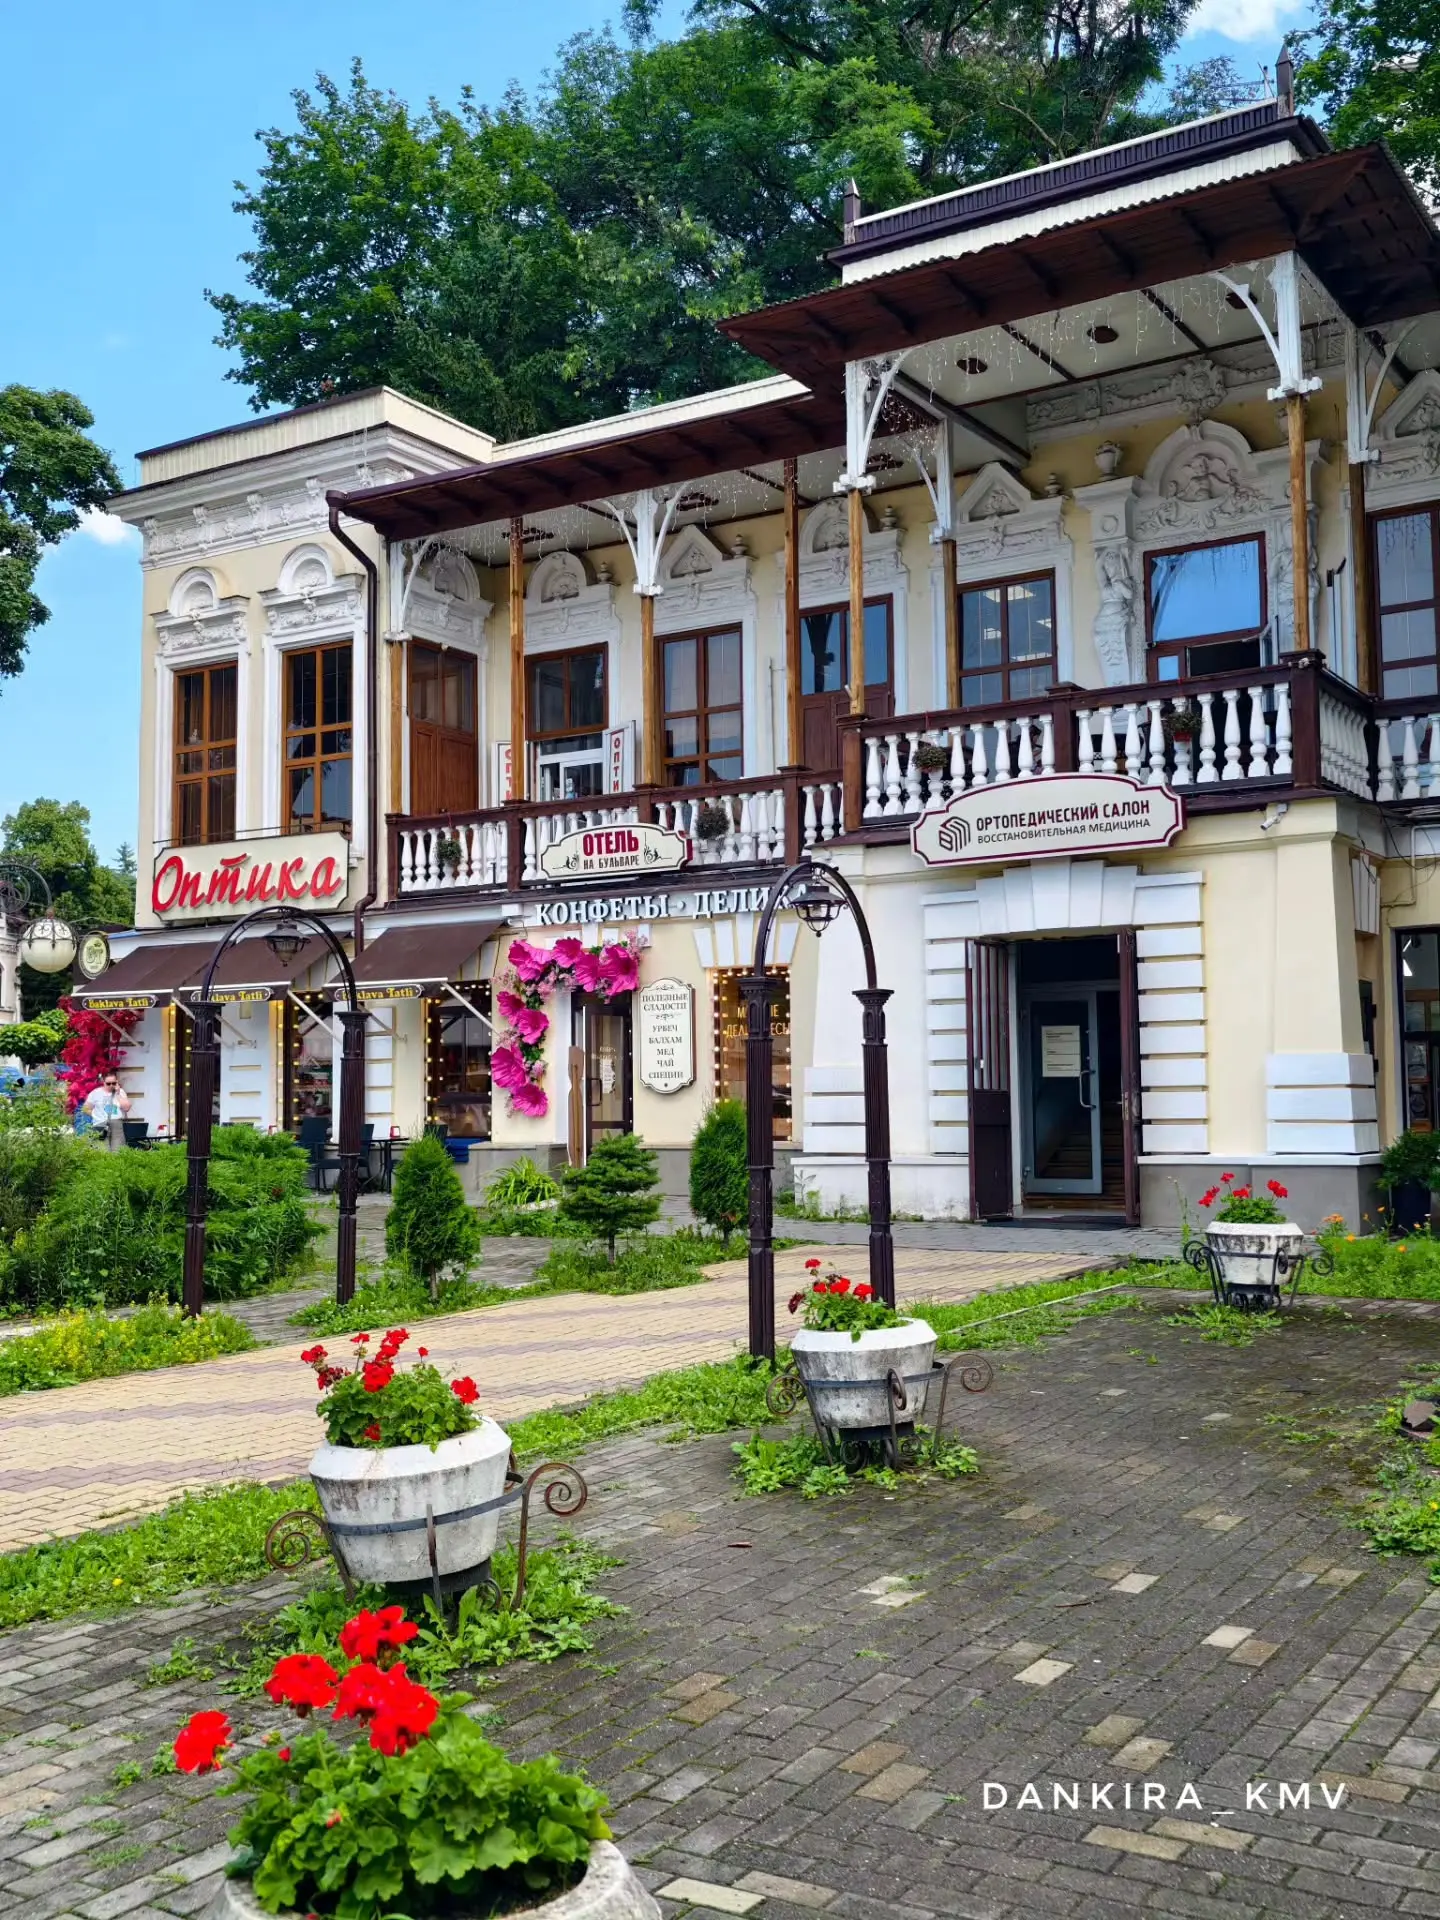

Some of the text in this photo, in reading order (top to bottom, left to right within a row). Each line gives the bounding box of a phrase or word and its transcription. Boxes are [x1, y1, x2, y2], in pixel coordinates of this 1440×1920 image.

[976, 800, 1150, 831] ОРТОПЕДИЧЕСКИЙ САЛОН
[977, 818, 1151, 844] ВОССТАНОВИТЕЛЬНАЯ МЕДИЦИНА
[583, 830, 639, 857] ОТЕЛЬ
[583, 855, 640, 870] НА БУЛЬВАРЕ
[152, 853, 344, 913] Оптика
[535, 895, 668, 925] КОНФЕТЫ
[642, 993, 688, 1003] ПОЛЕЗНЫЕ
[643, 1002, 687, 1012] СЛАДОСТИ
[652, 1024, 678, 1033] УРБЕЧ
[656, 1048, 675, 1056] МЕД
[656, 1059, 674, 1067] ЧАЙ
[648, 1071, 684, 1079] СПЕЦИИ
